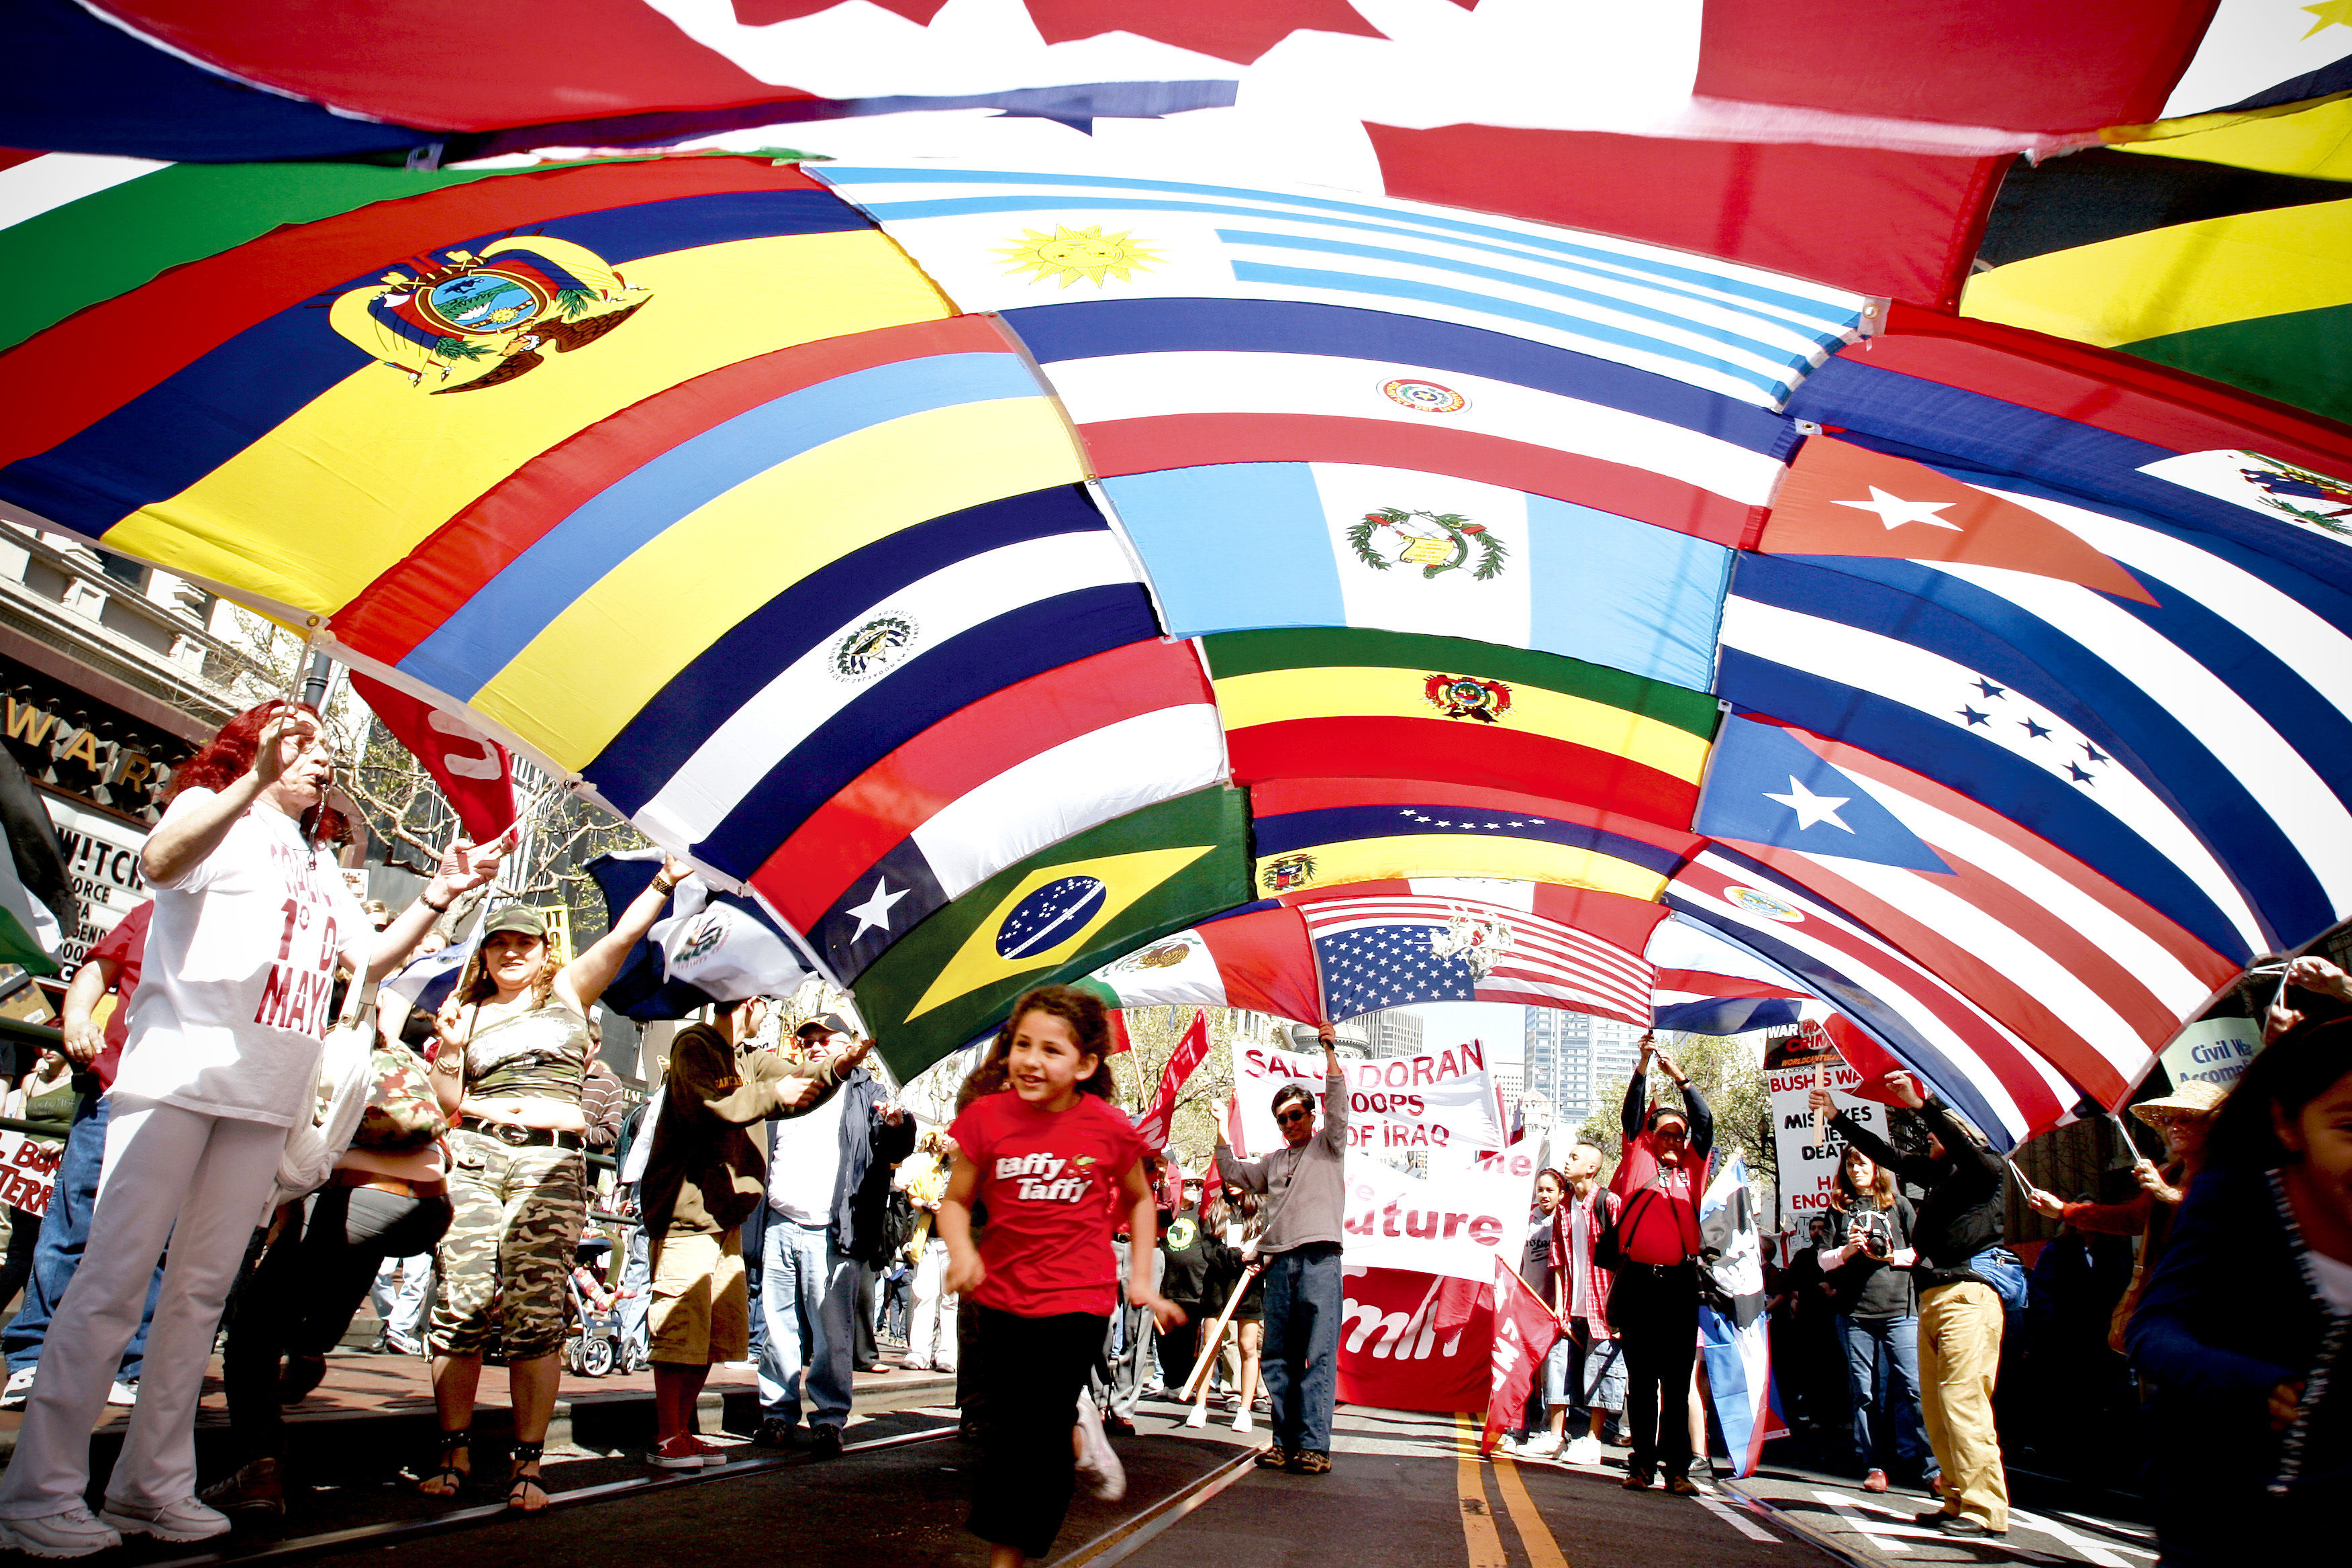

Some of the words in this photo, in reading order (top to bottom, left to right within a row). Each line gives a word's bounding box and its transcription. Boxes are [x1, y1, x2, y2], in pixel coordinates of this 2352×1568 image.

[72, 877, 111, 903] ORCE
[1768, 1023, 1799, 1039] WAR
[2191, 1040, 2232, 1064] Civil
[1770, 1072, 1832, 1093] BUSHS
[1836, 1069, 1861, 1085] WA
[1315, 1092, 1425, 1116] TOOPS
[1802, 1142, 1848, 1161] DEAT
[0, 1164, 54, 1214] TERR
[1016, 1177, 1093, 1203] Taffy
[1344, 1193, 1503, 1246] uture
